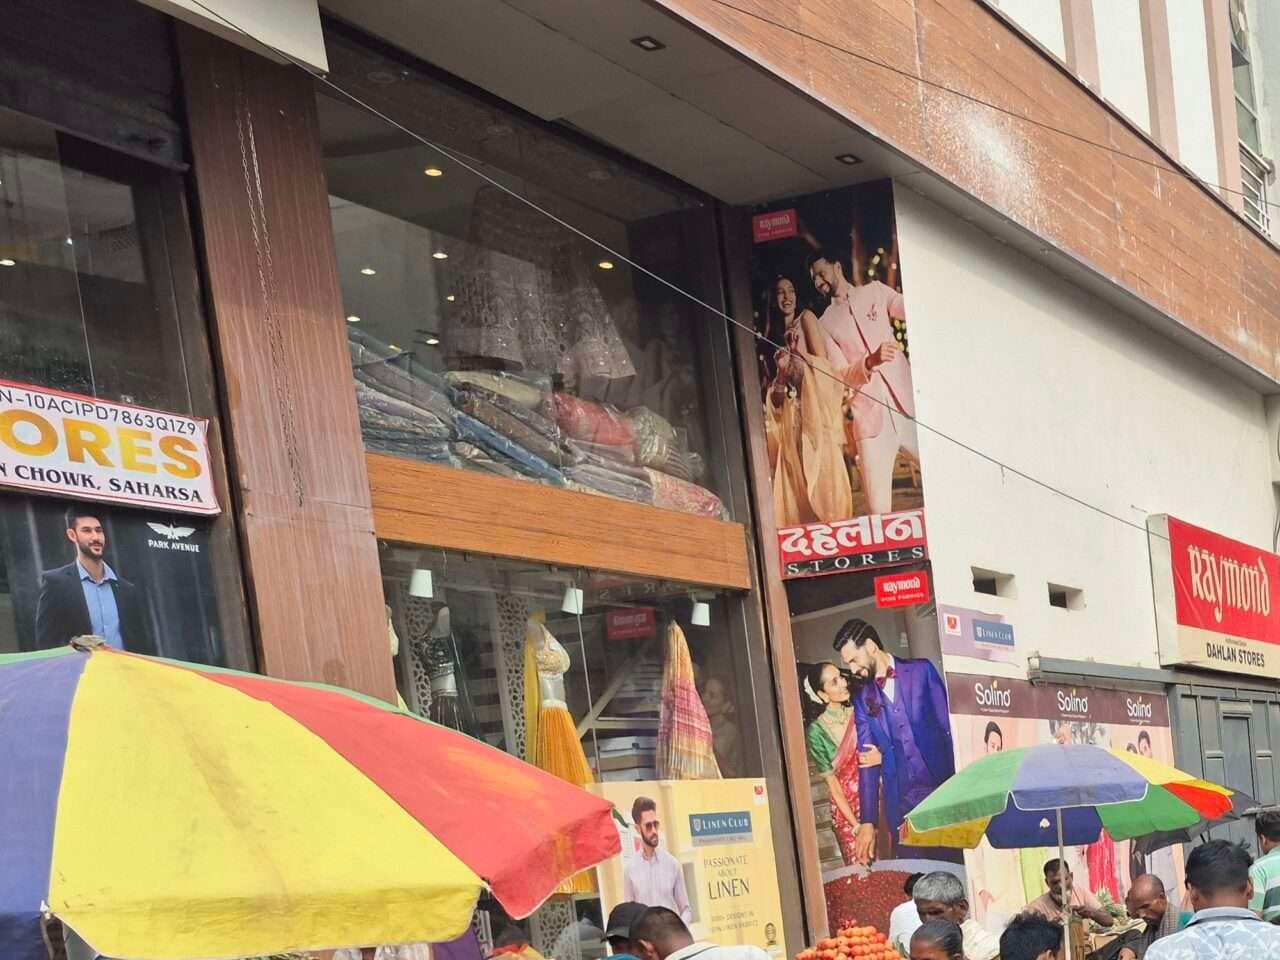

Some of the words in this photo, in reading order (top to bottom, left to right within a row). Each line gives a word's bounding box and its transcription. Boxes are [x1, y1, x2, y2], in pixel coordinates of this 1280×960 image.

[15, 465, 101, 490] CHOWK,
[109, 478, 204, 503] SAHARSA
[147, 539, 170, 550] PARK
[171, 541, 201, 553] AVENUE
[787, 547, 924, 575] STORES
[1187, 544, 1271, 623] Raymond
[1206, 641, 1237, 664] DAHLAN
[1238, 648, 1265, 668] STORES
[708, 878, 750, 900] LINEN
